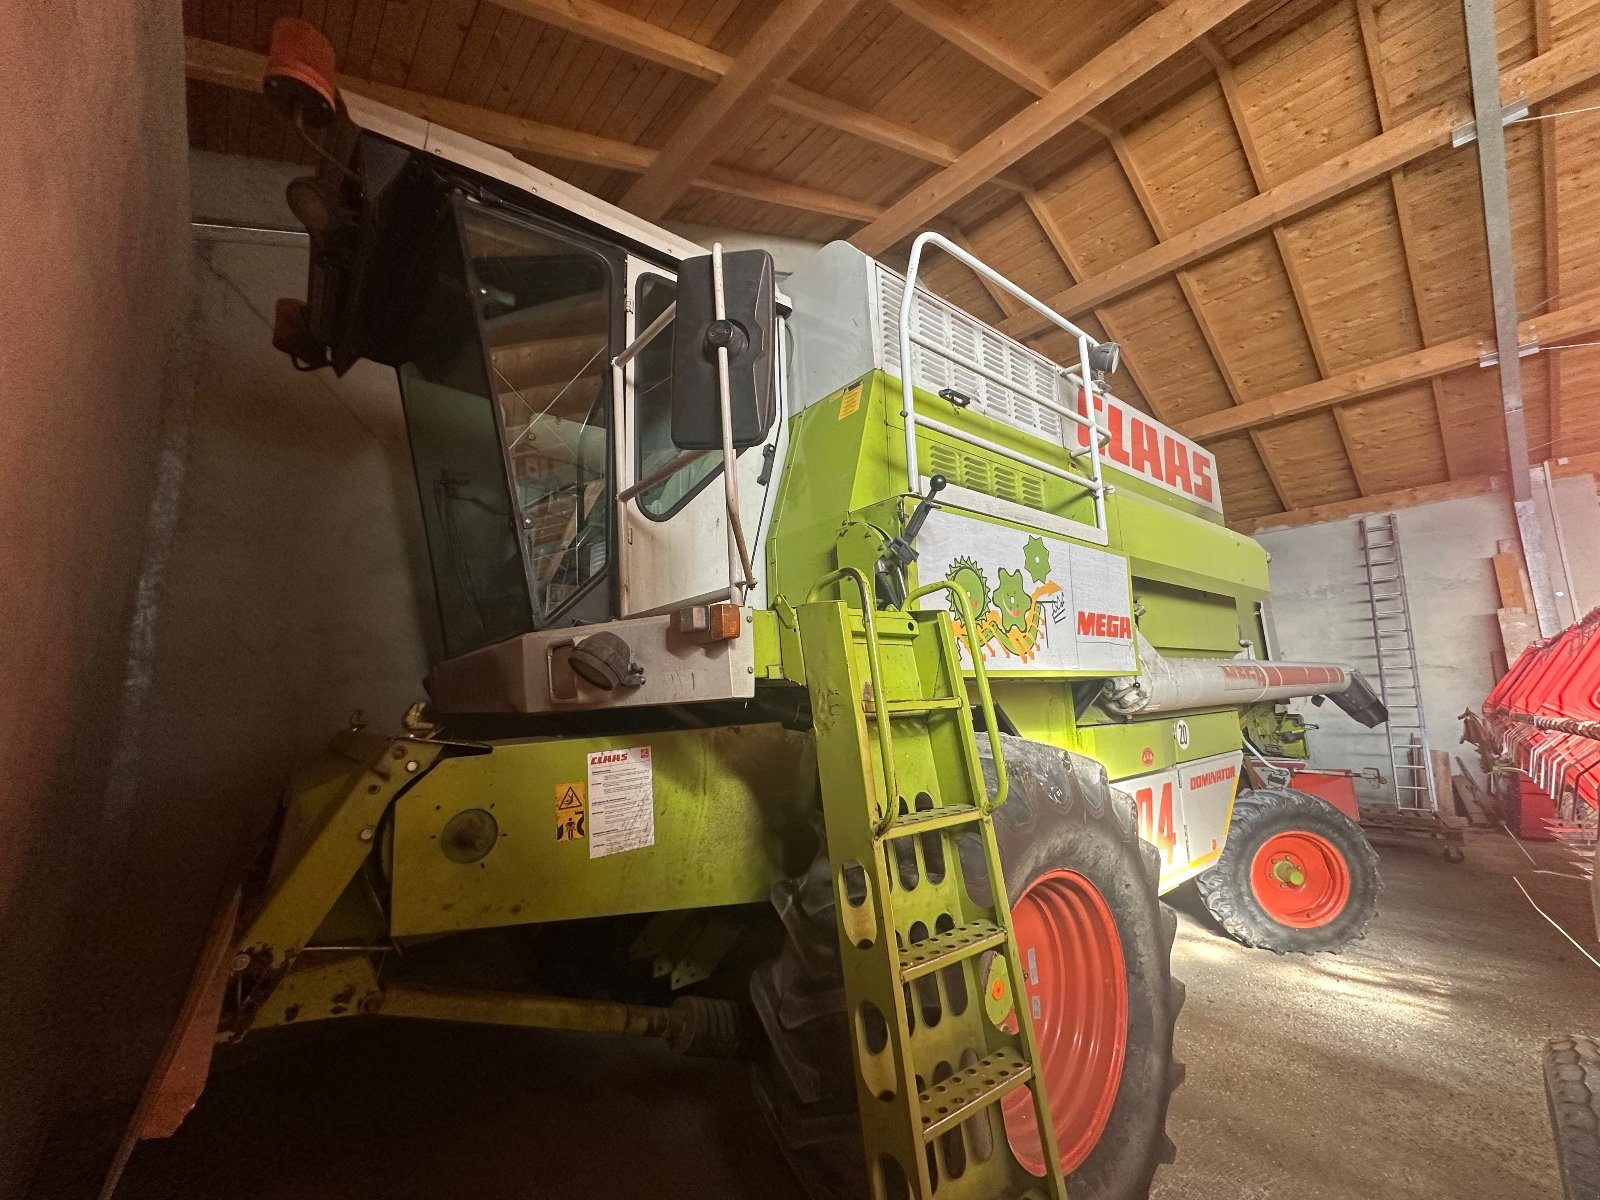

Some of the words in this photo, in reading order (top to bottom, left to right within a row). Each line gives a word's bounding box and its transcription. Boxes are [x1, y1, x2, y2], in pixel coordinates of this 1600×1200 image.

[1077, 387, 1213, 504] CLAAS
[1077, 610, 1132, 639] MEGA
[1178, 724, 1188, 745] 20
[590, 753, 628, 765] CLAAS
[1189, 766, 1236, 791] DOMINATOR
